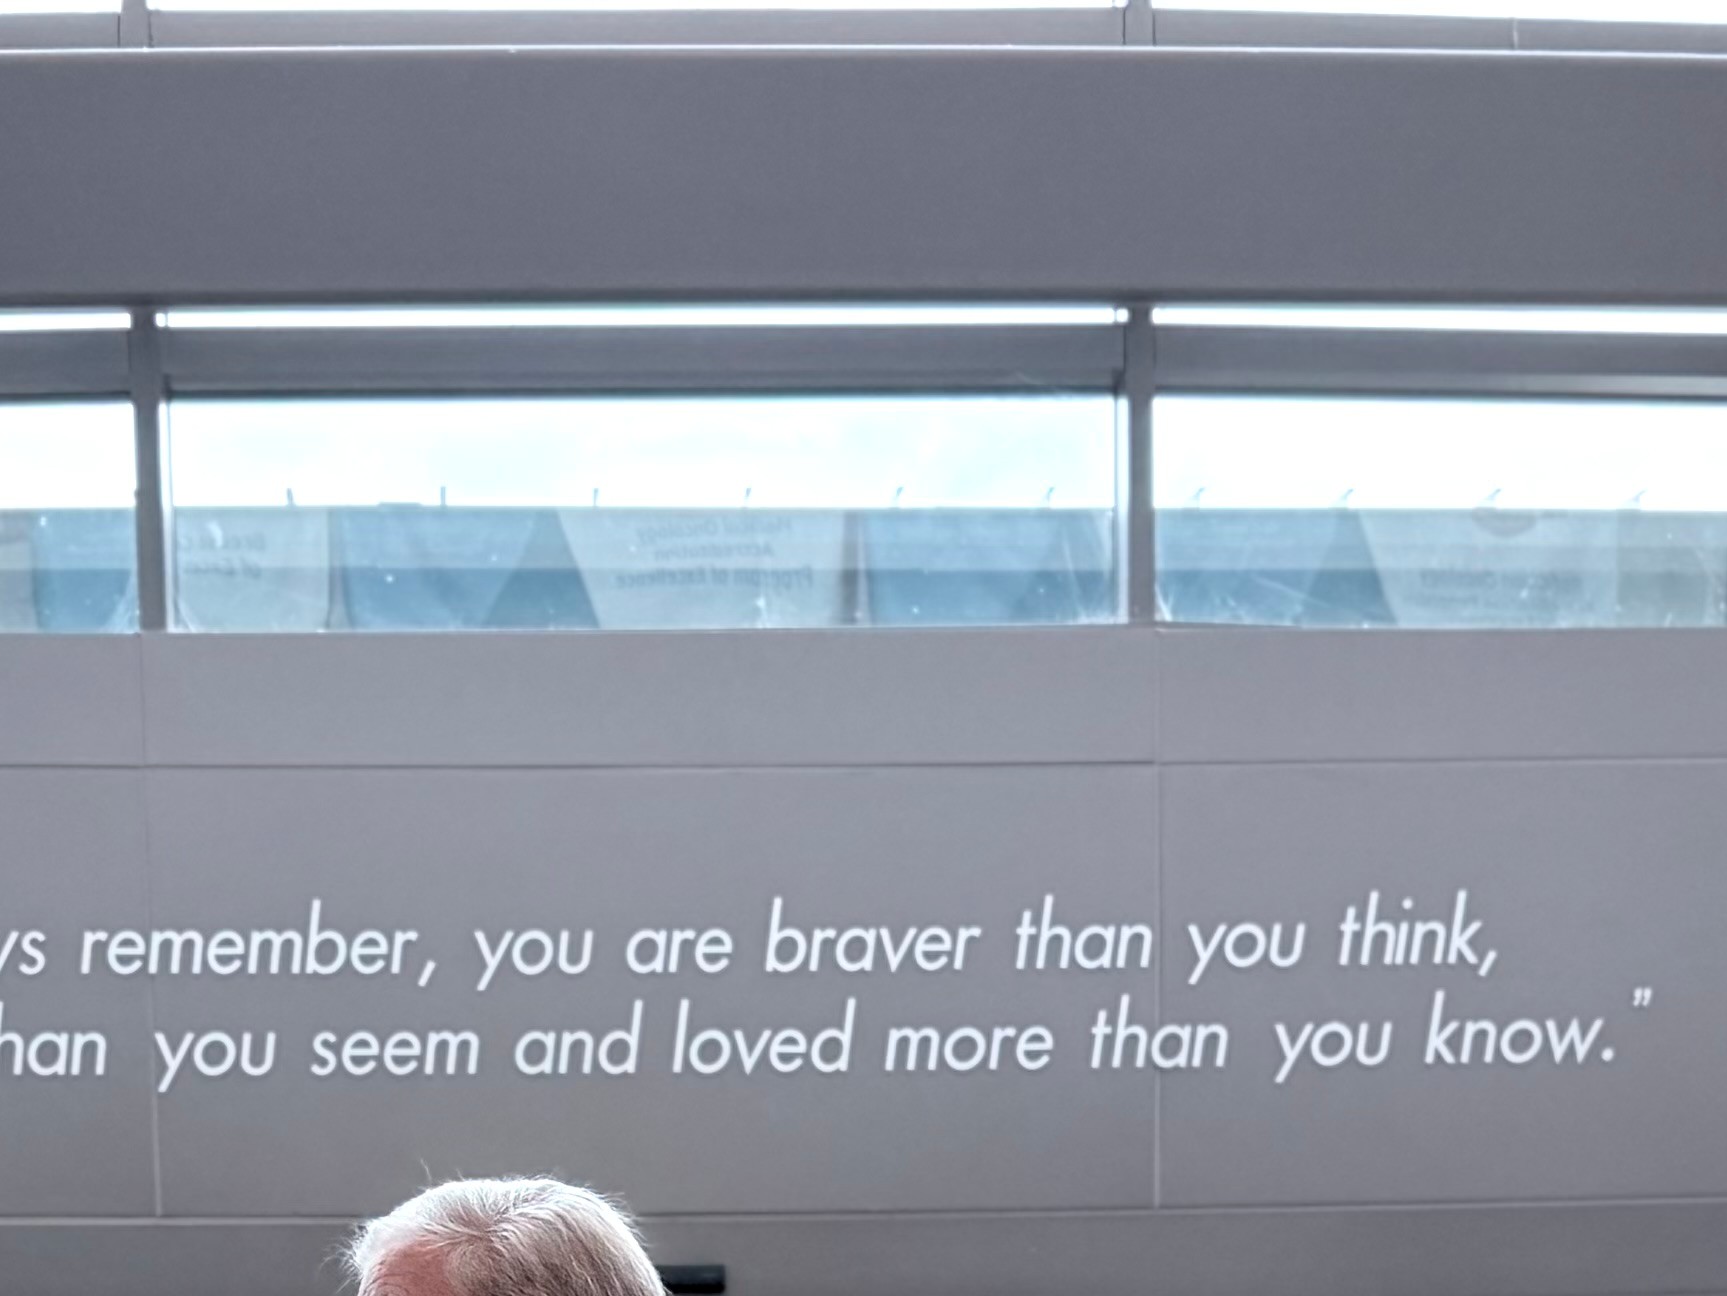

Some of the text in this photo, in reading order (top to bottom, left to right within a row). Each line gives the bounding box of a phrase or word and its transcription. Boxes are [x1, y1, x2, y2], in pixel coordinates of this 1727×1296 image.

[79, 897, 437, 988] remember,
[473, 928, 595, 992] you
[625, 927, 734, 975] are
[764, 895, 983, 974] braver
[1014, 892, 1154, 971] than
[1186, 921, 1307, 986] you
[1338, 888, 1498, 978] think,
[153, 1030, 277, 1094] you
[309, 1029, 481, 1077] seem
[513, 998, 645, 1076] and
[671, 996, 858, 1076] loved
[884, 1024, 1055, 1072] more
[1090, 992, 1230, 1070] than
[1274, 1020, 1394, 1084] you
